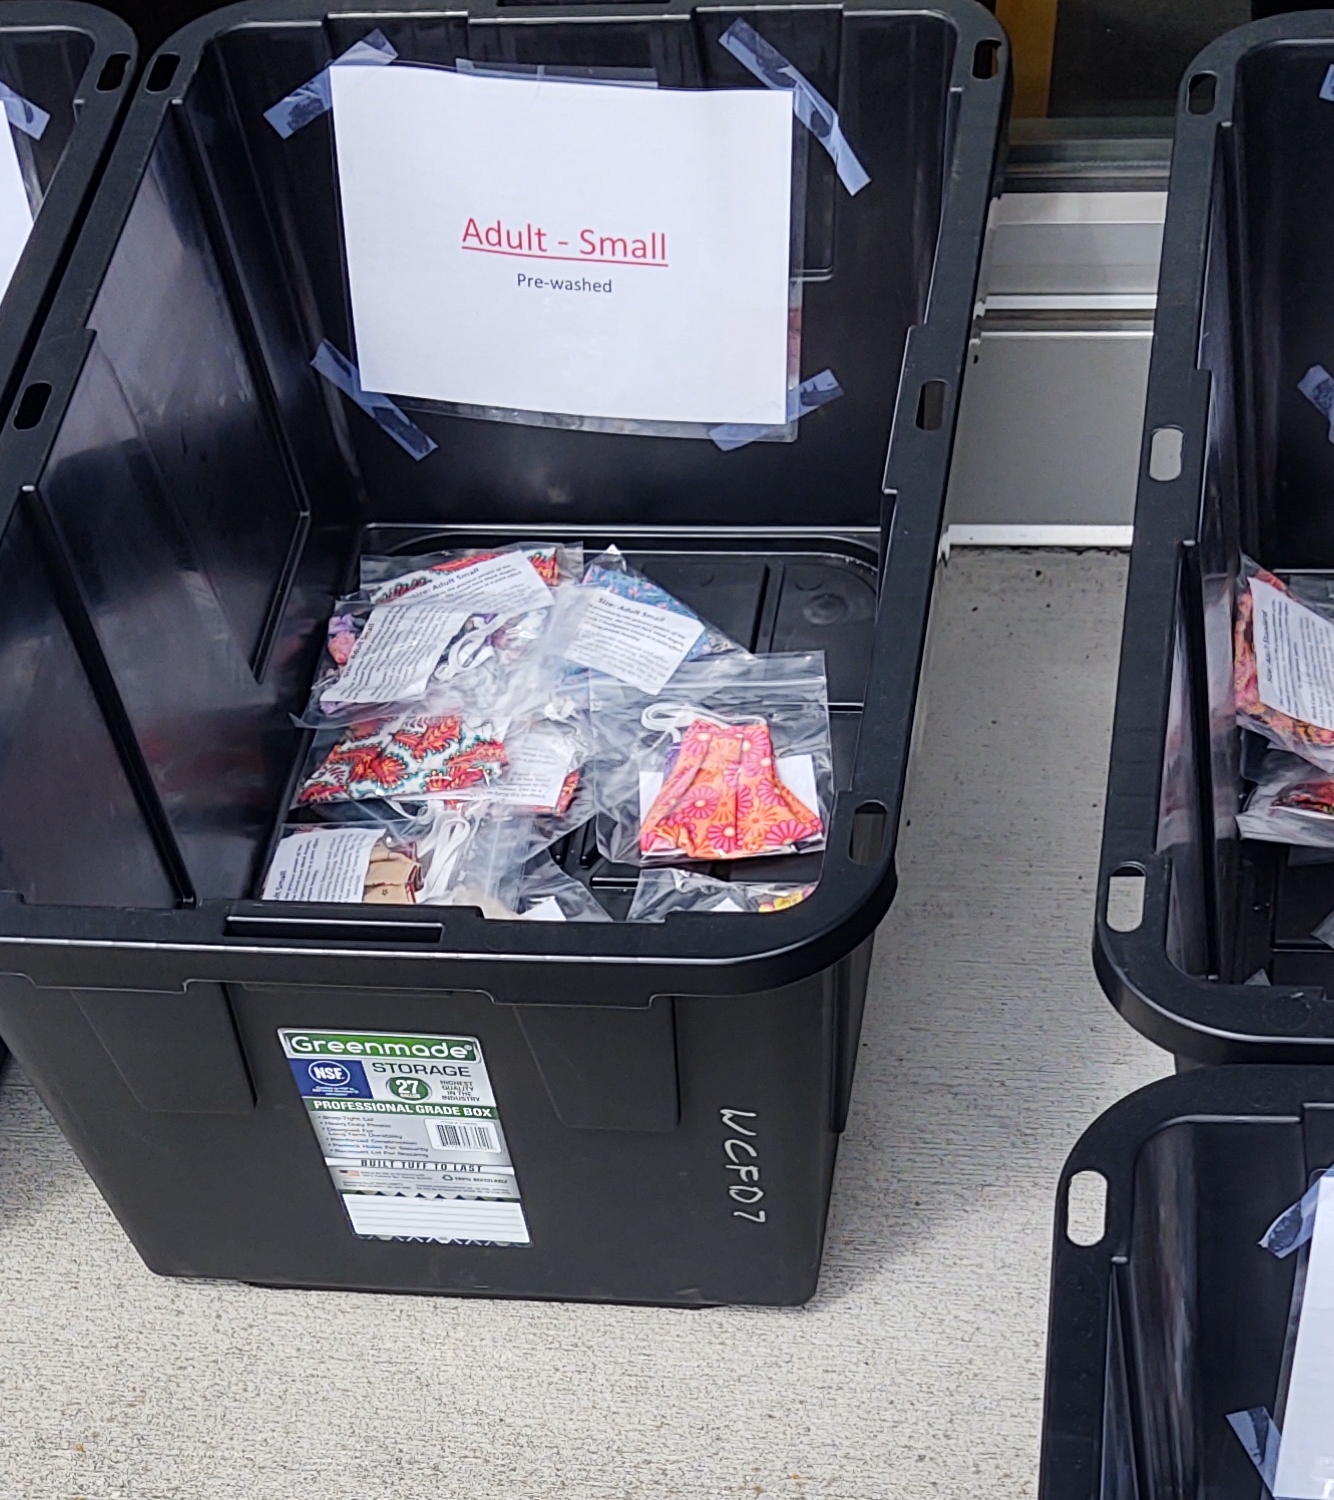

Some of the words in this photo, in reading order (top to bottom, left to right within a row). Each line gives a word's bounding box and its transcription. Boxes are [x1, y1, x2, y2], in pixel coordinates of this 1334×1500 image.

[462, 217, 547, 252] Adult
[579, 229, 666, 261] Small
[517, 273, 612, 293] Pre-washed
[431, 576, 456, 591] Adult
[455, 566, 480, 580] Small
[616, 604, 640, 616] Adult
[640, 610, 665, 624] Small
[291, 1036, 468, 1059] Greenmade
[313, 1067, 343, 1080] NSF
[372, 1062, 471, 1077] STORAGE
[395, 1080, 419, 1094] 27
[313, 1100, 415, 1113] PROFESSIONAL
[416, 1105, 461, 1116] GRADE
[463, 1108, 492, 1117] BOX
[361, 1160, 395, 1168] BUILT
[401, 1161, 428, 1169] TUFF
[434, 1163, 447, 1171] TO
[454, 1164, 483, 1172] LAST
